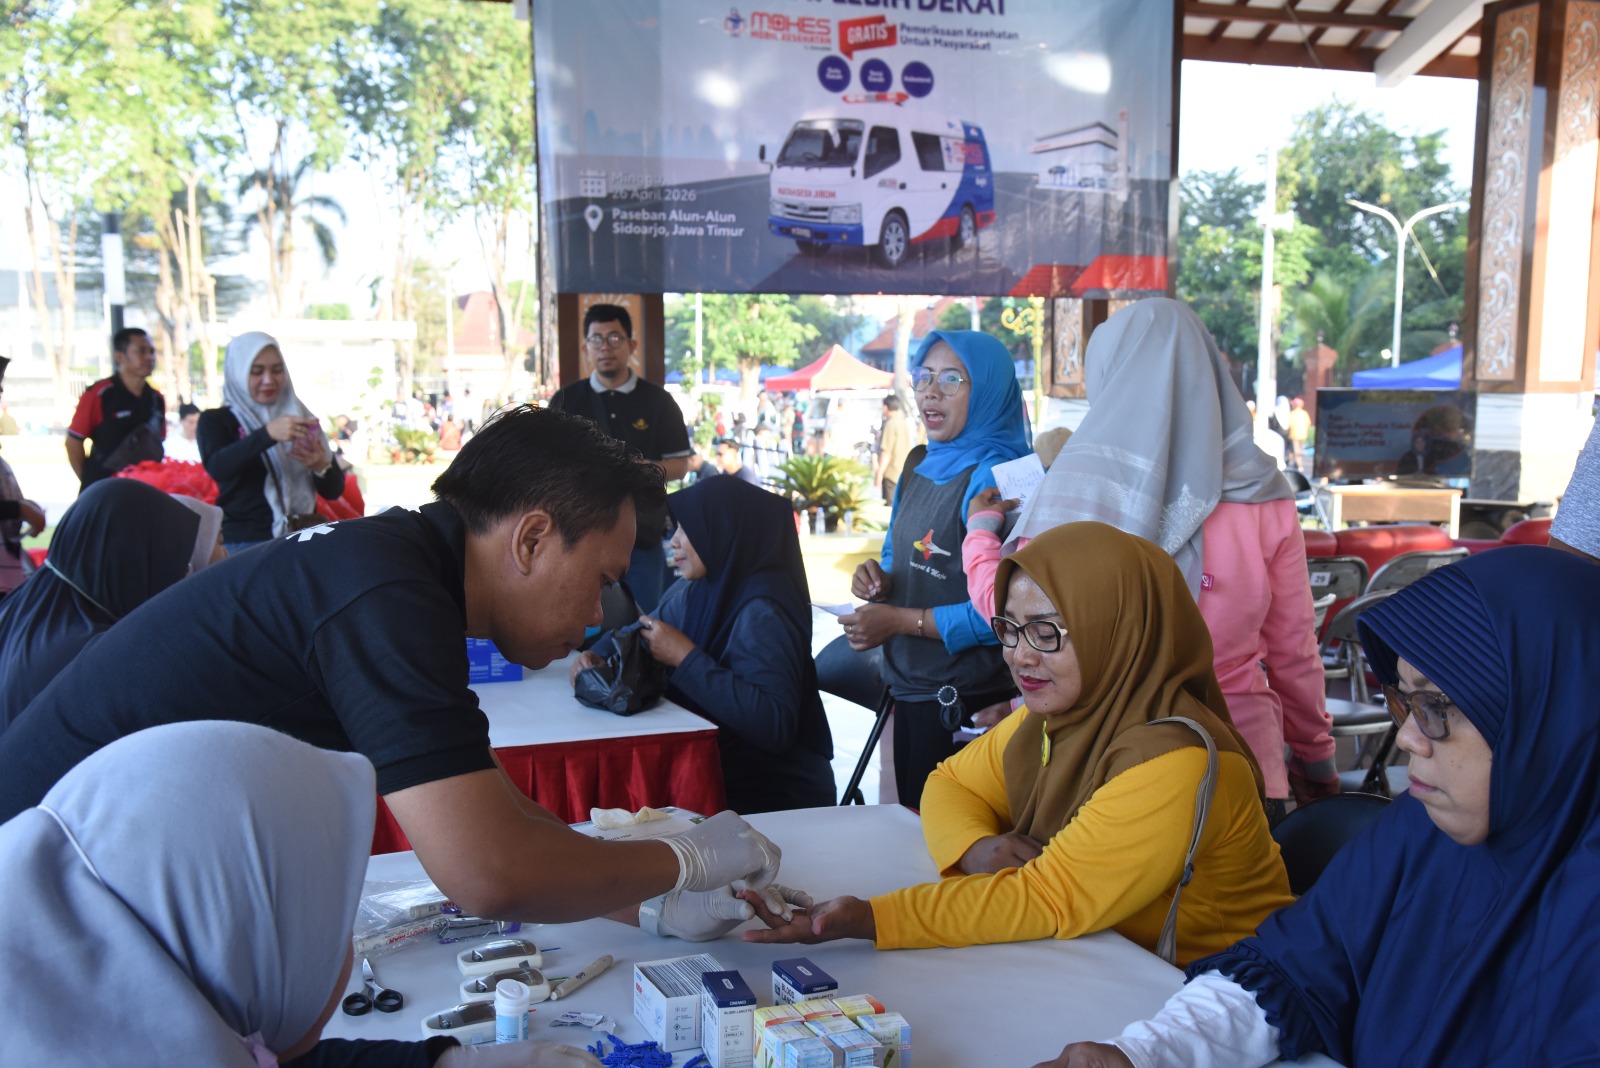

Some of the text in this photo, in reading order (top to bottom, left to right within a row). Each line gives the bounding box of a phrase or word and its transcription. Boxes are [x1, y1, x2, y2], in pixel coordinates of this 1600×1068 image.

[847, 22, 889, 45] GRATIS
[900, 23, 1019, 40] Pemeriksaan Kesehatan
[900, 36, 930, 47] Untuk
[631, 189, 661, 203] April
[665, 188, 697, 201] 2026
[612, 208, 736, 222] Paseban Alun-Alun
[612, 222, 744, 238] Sidoarjo, Jawa Timur
